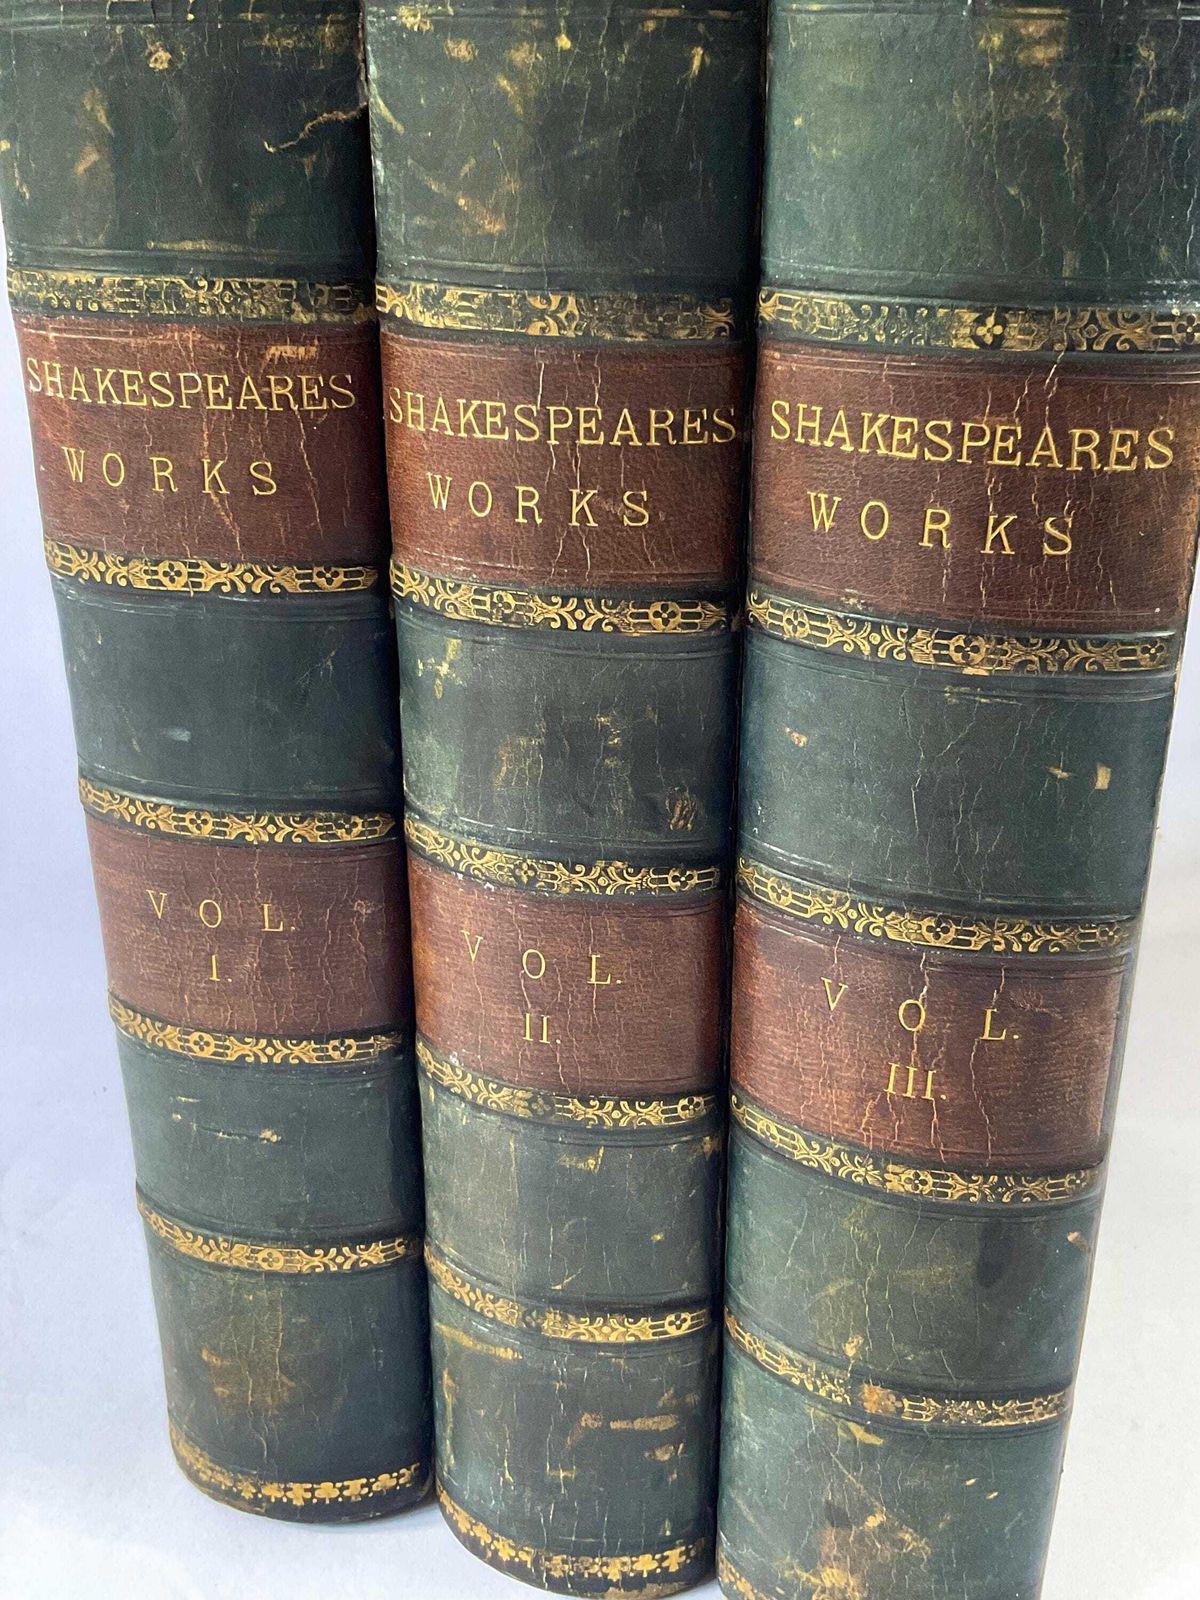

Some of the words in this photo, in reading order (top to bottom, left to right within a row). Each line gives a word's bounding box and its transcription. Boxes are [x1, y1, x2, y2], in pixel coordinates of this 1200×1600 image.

[27, 357, 356, 411] SHAKESPEARES
[388, 387, 737, 446] SHAKESPEARES
[771, 400, 1175, 472] SHAKESPEARES
[61, 446, 278, 496] WORKS
[426, 471, 650, 527] WORKS
[807, 491, 1073, 555] WORKS
[146, 889, 296, 932] VOL.
[461, 930, 622, 985] VOL.
[523, 1013, 561, 1044] II.
[821, 977, 1020, 1040] VOL.
[883, 1062, 947, 1100] III.
